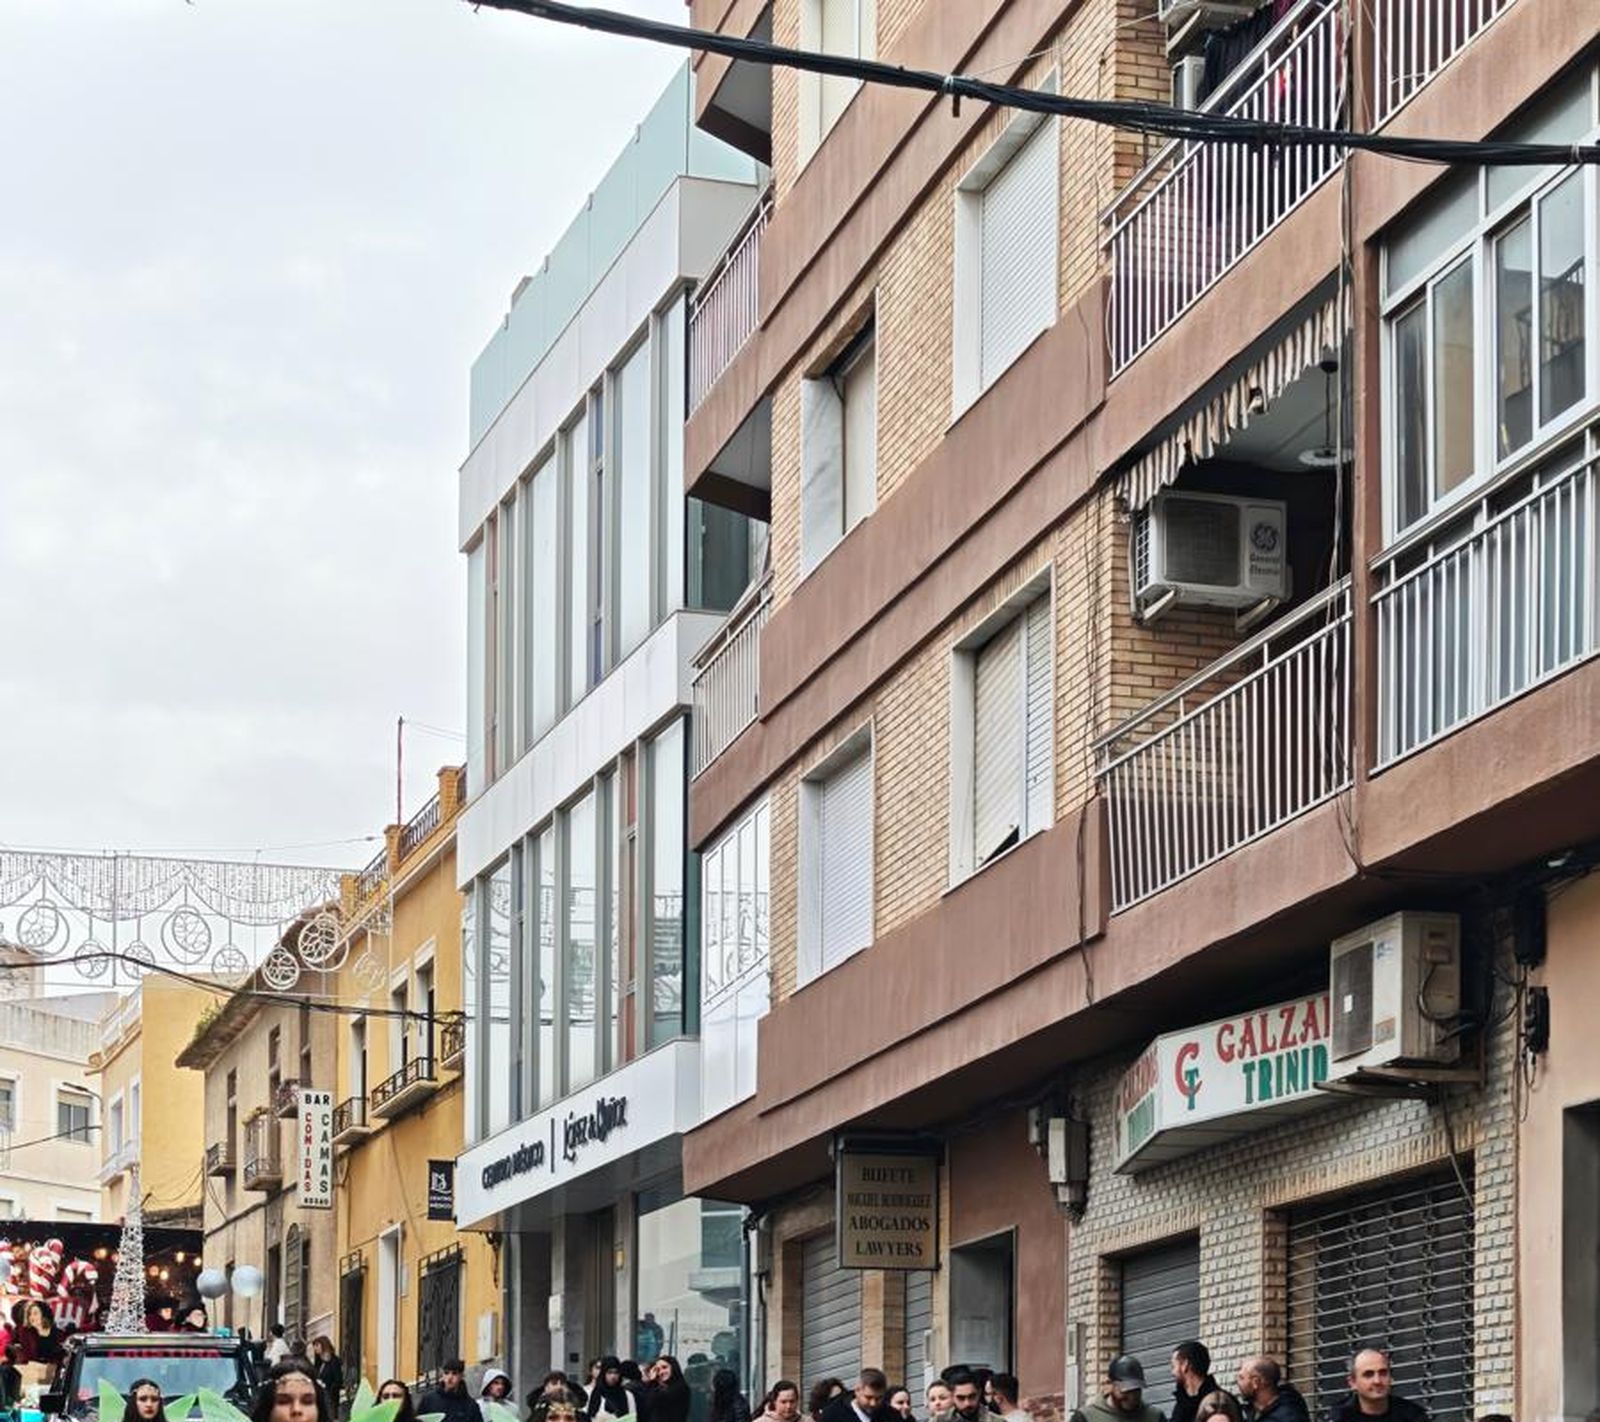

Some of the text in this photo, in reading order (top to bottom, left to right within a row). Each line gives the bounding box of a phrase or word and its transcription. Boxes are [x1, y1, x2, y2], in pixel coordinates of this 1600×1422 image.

[305, 1094, 330, 1105] BAR
[304, 1112, 312, 1192] COMIDAS
[319, 1114, 330, 1193] CAMAS
[482, 1155, 511, 1189] CENTRO
[861, 1166, 914, 1183] BUFETE
[849, 1215, 931, 1231] ABOGADOS
[855, 1241, 923, 1257] LAWYERS
